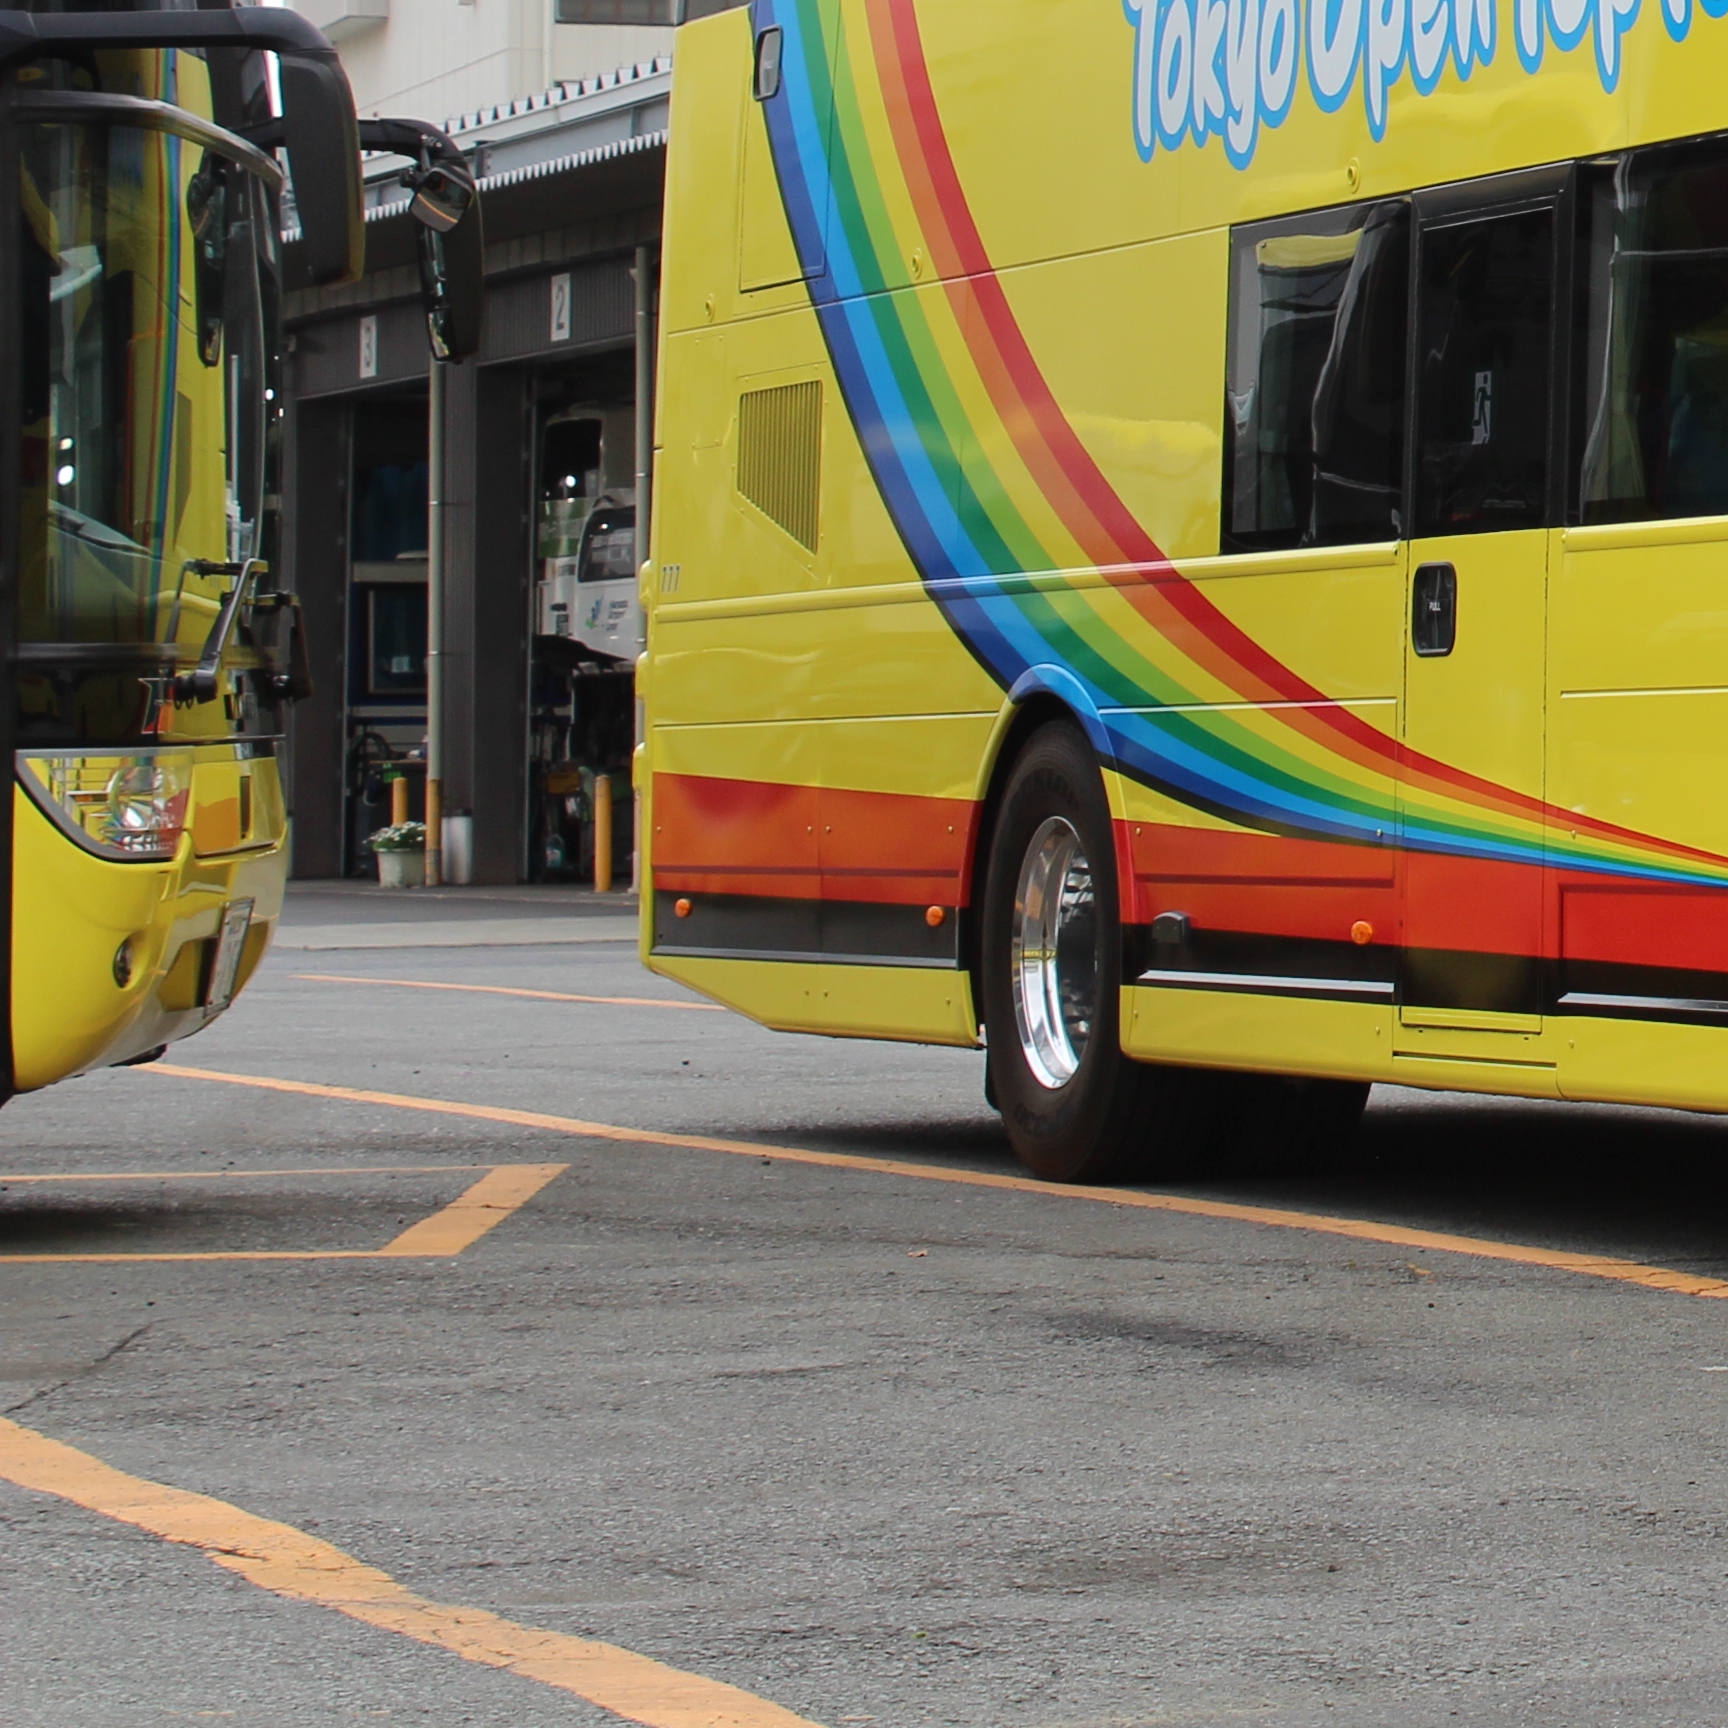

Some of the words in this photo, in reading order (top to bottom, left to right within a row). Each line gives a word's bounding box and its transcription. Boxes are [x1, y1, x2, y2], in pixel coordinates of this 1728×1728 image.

[555, 284, 566, 330] 2
[363, 325, 374, 368] 3
[661, 565, 681, 593] 111
